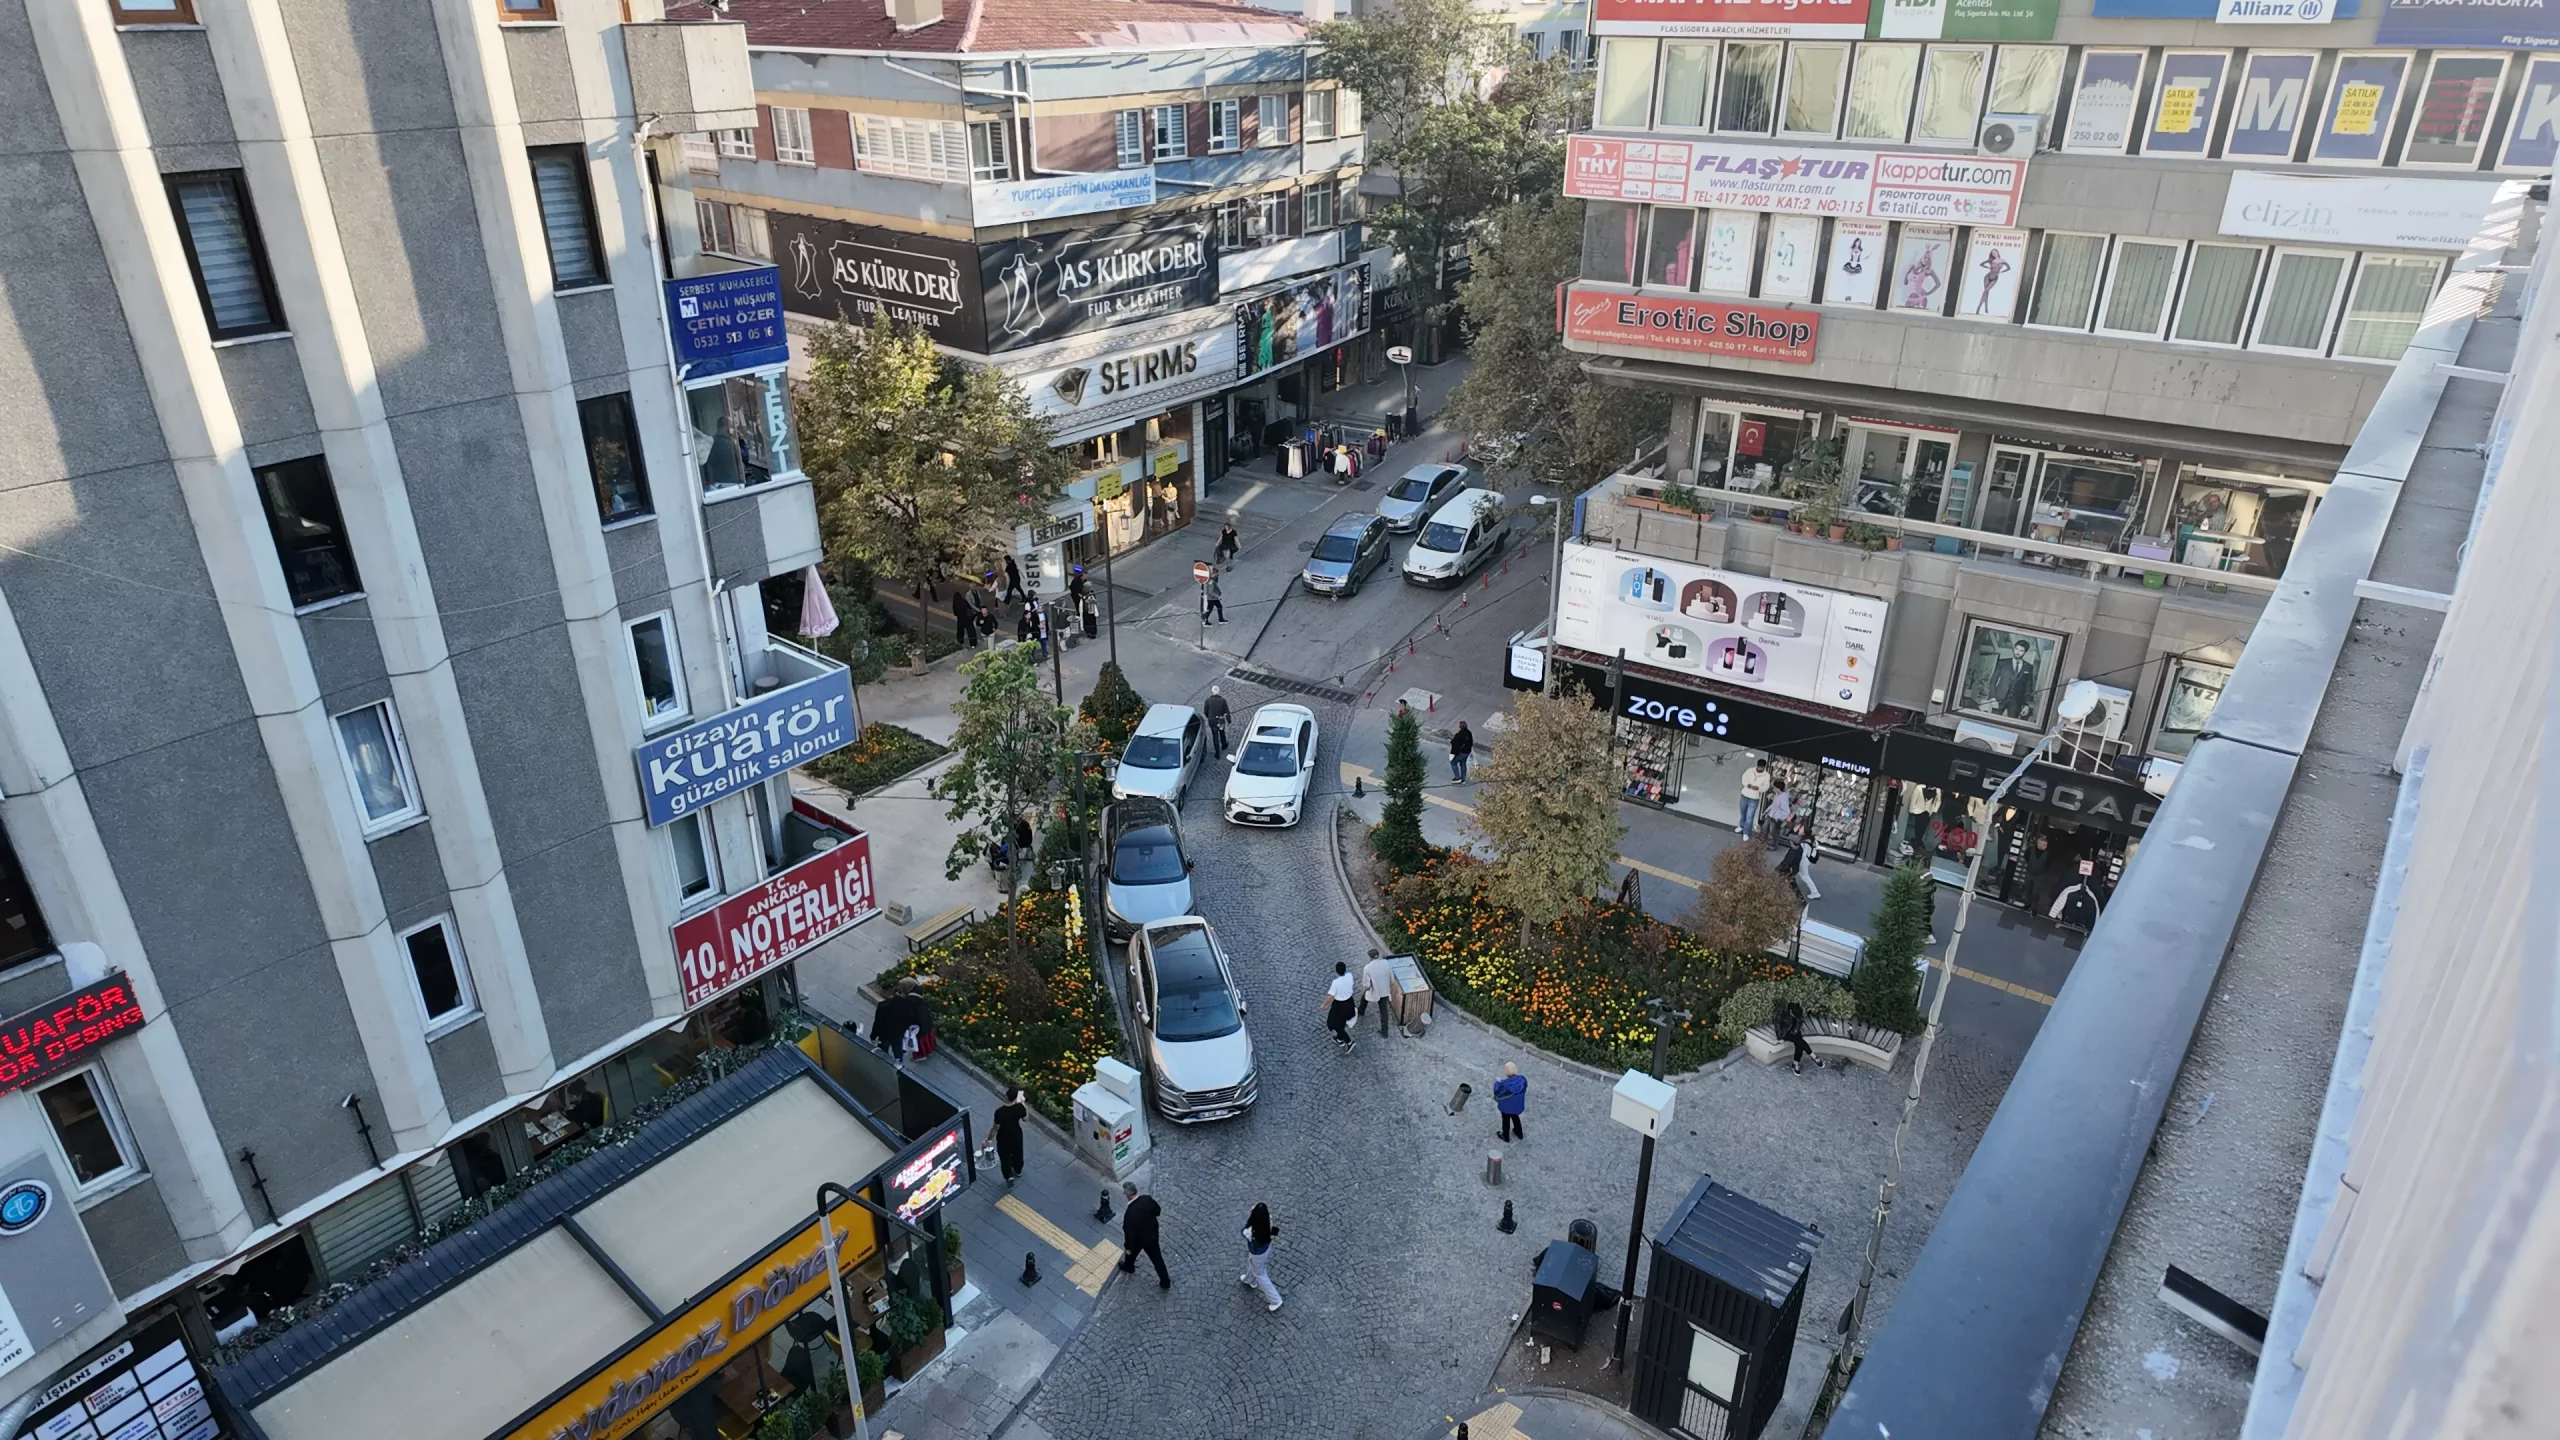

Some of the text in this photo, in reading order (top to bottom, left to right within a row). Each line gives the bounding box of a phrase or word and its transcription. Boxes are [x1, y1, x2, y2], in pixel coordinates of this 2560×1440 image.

[2229, 0, 2293, 16] Allianz
[1660, 25, 1791, 35] FLAŞ SİGORTA ARACILIK HİZMETLERİ
[2502, 35, 2559, 47] Flaş Sigorta
[2166, 89, 2197, 99] SATILIK
[2345, 88, 2379, 98] SATILIK
[2073, 131, 2119, 142] 250 02 00
[1579, 157, 1618, 174] THY
[1881, 160, 2012, 185] kappatur.com
[1011, 174, 1151, 203] YURTDIŞI EĞİTİM DANIŞMANLIĞI
[1710, 178, 1837, 195] www.flasturizm.com.tr
[1879, 190, 1952, 202] PRONTOTOUR
[1693, 190, 1864, 214] TEL: 417 2002 KAT:2 NO:115
[1893, 201, 1948, 216] tatil.com
[2242, 199, 2333, 227] elizin
[1061, 234, 1203, 291] AS KÜRK DERİ
[679, 273, 774, 297] SERBEST MUHASEBECİ
[835, 257, 958, 303] AS KÜRK DERİ
[702, 292, 776, 312] MALİ MÜŞAVİR
[856, 299, 940, 328] FUR LEATHER
[1087, 286, 1183, 317] FUR & LEATHER
[687, 308, 776, 335] ÇETİN ÖZER
[1617, 300, 1811, 348] Erotic Shop
[693, 326, 774, 349] 0532 513 05 16
[1665, 336, 1680, 345] 418
[1680, 337, 1691, 346] 38
[1693, 338, 1702, 346] 17
[1708, 339, 1723, 349] 425
[1724, 341, 1735, 350] 50
[1736, 342, 1746, 351] 17
[1101, 342, 1197, 395] SETRMS
[1036, 518, 1078, 541] SETRMS
[1845, 641, 1865, 650] KARL
[1628, 695, 1696, 727] zore
[665, 712, 760, 760] dizayn
[670, 728, 840, 814] güzellik salonu
[1821, 756, 1871, 775] PREMIUM
[1931, 821, 1979, 849] %50
[765, 877, 790, 896] T.C.
[747, 880, 809, 919] ANKARA
[682, 855, 872, 987] 10. NOTERLİĞİ
[688, 984, 718, 1004] TEL
[730, 958, 755, 982] 417
[760, 948, 776, 966] 12
[780, 938, 797, 956] 50
[808, 920, 831, 941] 417
[835, 910, 850, 925] 12
[853, 899, 869, 916] 52
[0, 986, 128, 1062] UAFÖR
[45, 1005, 142, 1062] DESING
[47, 1368, 92, 1400] İŞHANI
